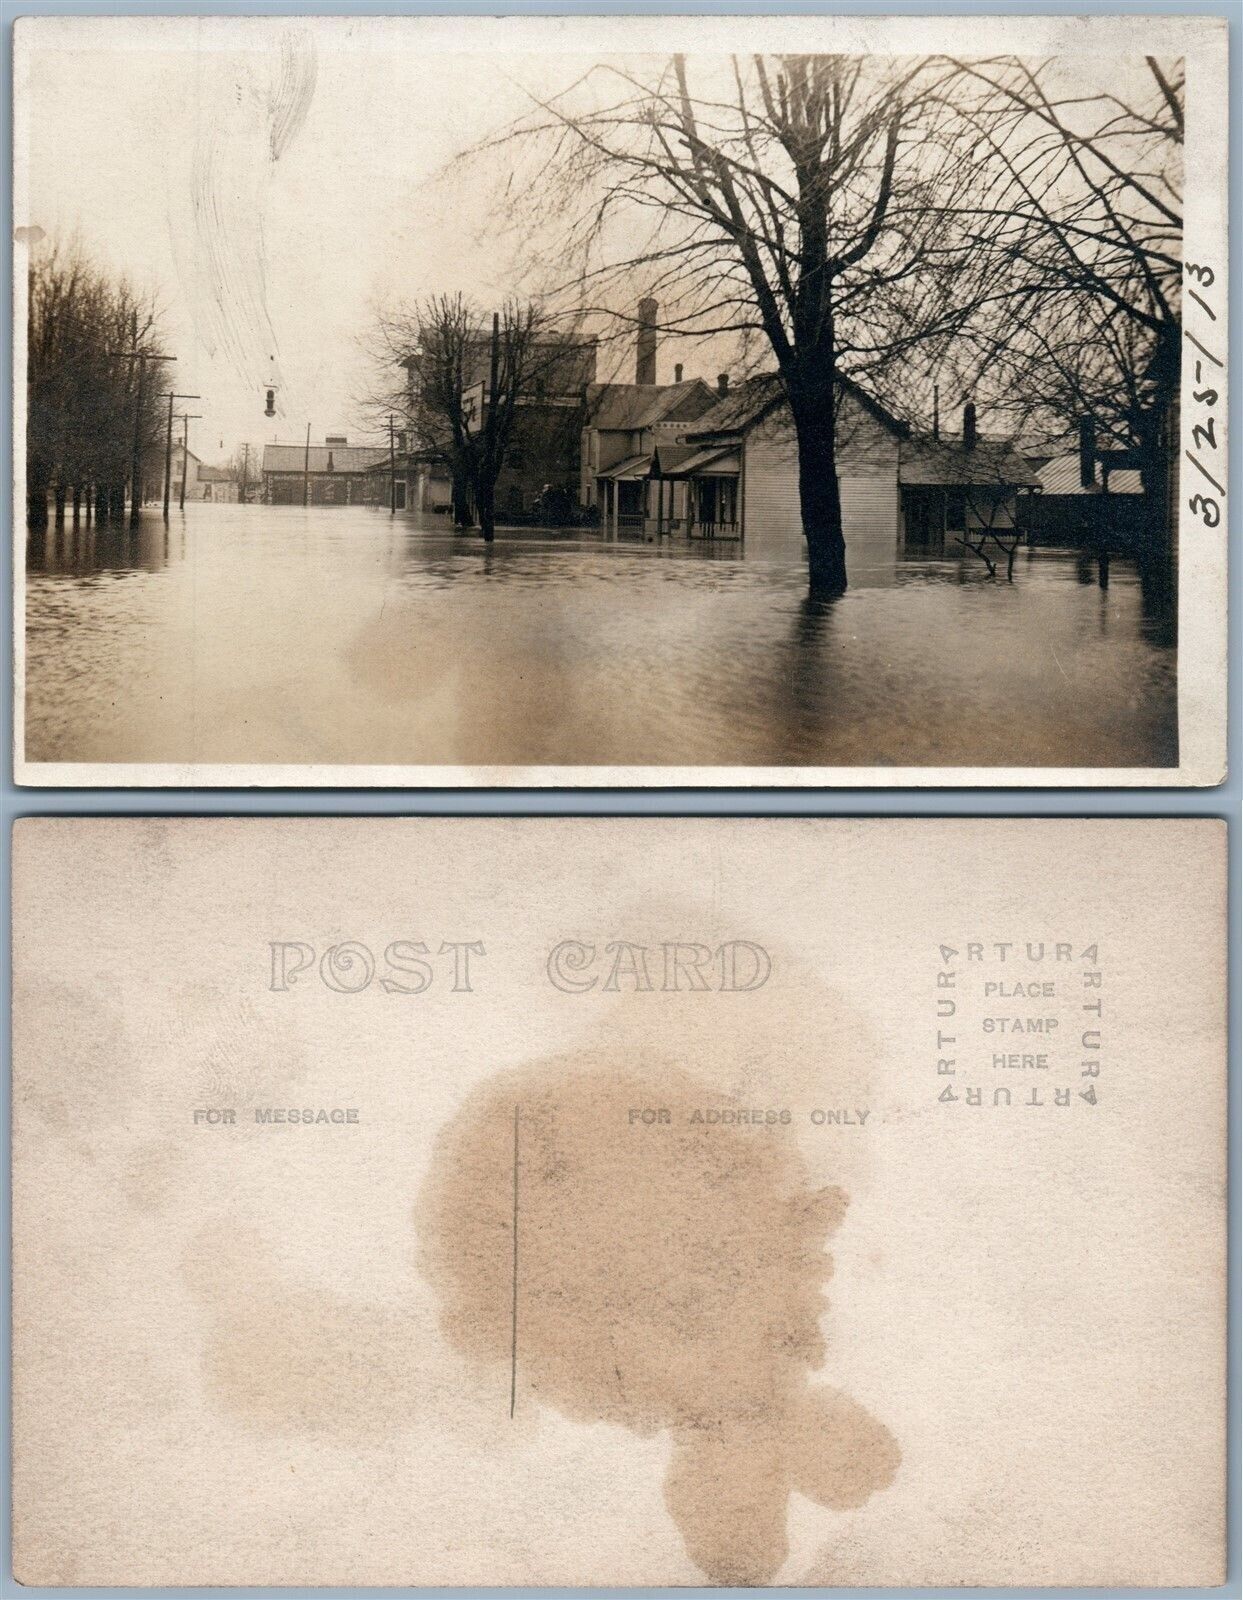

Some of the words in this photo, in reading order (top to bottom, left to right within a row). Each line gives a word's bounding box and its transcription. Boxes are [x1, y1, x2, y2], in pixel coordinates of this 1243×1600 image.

[267, 939, 488, 994] POST
[546, 939, 772, 994] CARD
[984, 981, 1056, 998] PLACE
[982, 1017, 1060, 1034] STAMP
[992, 1053, 1049, 1069] HERE
[193, 1108, 237, 1125] FOR
[255, 1108, 360, 1125] MESSAGE
[628, 1108, 672, 1125] FOR
[690, 1108, 792, 1125] ADDRESS
[810, 1108, 871, 1125] ONLY
